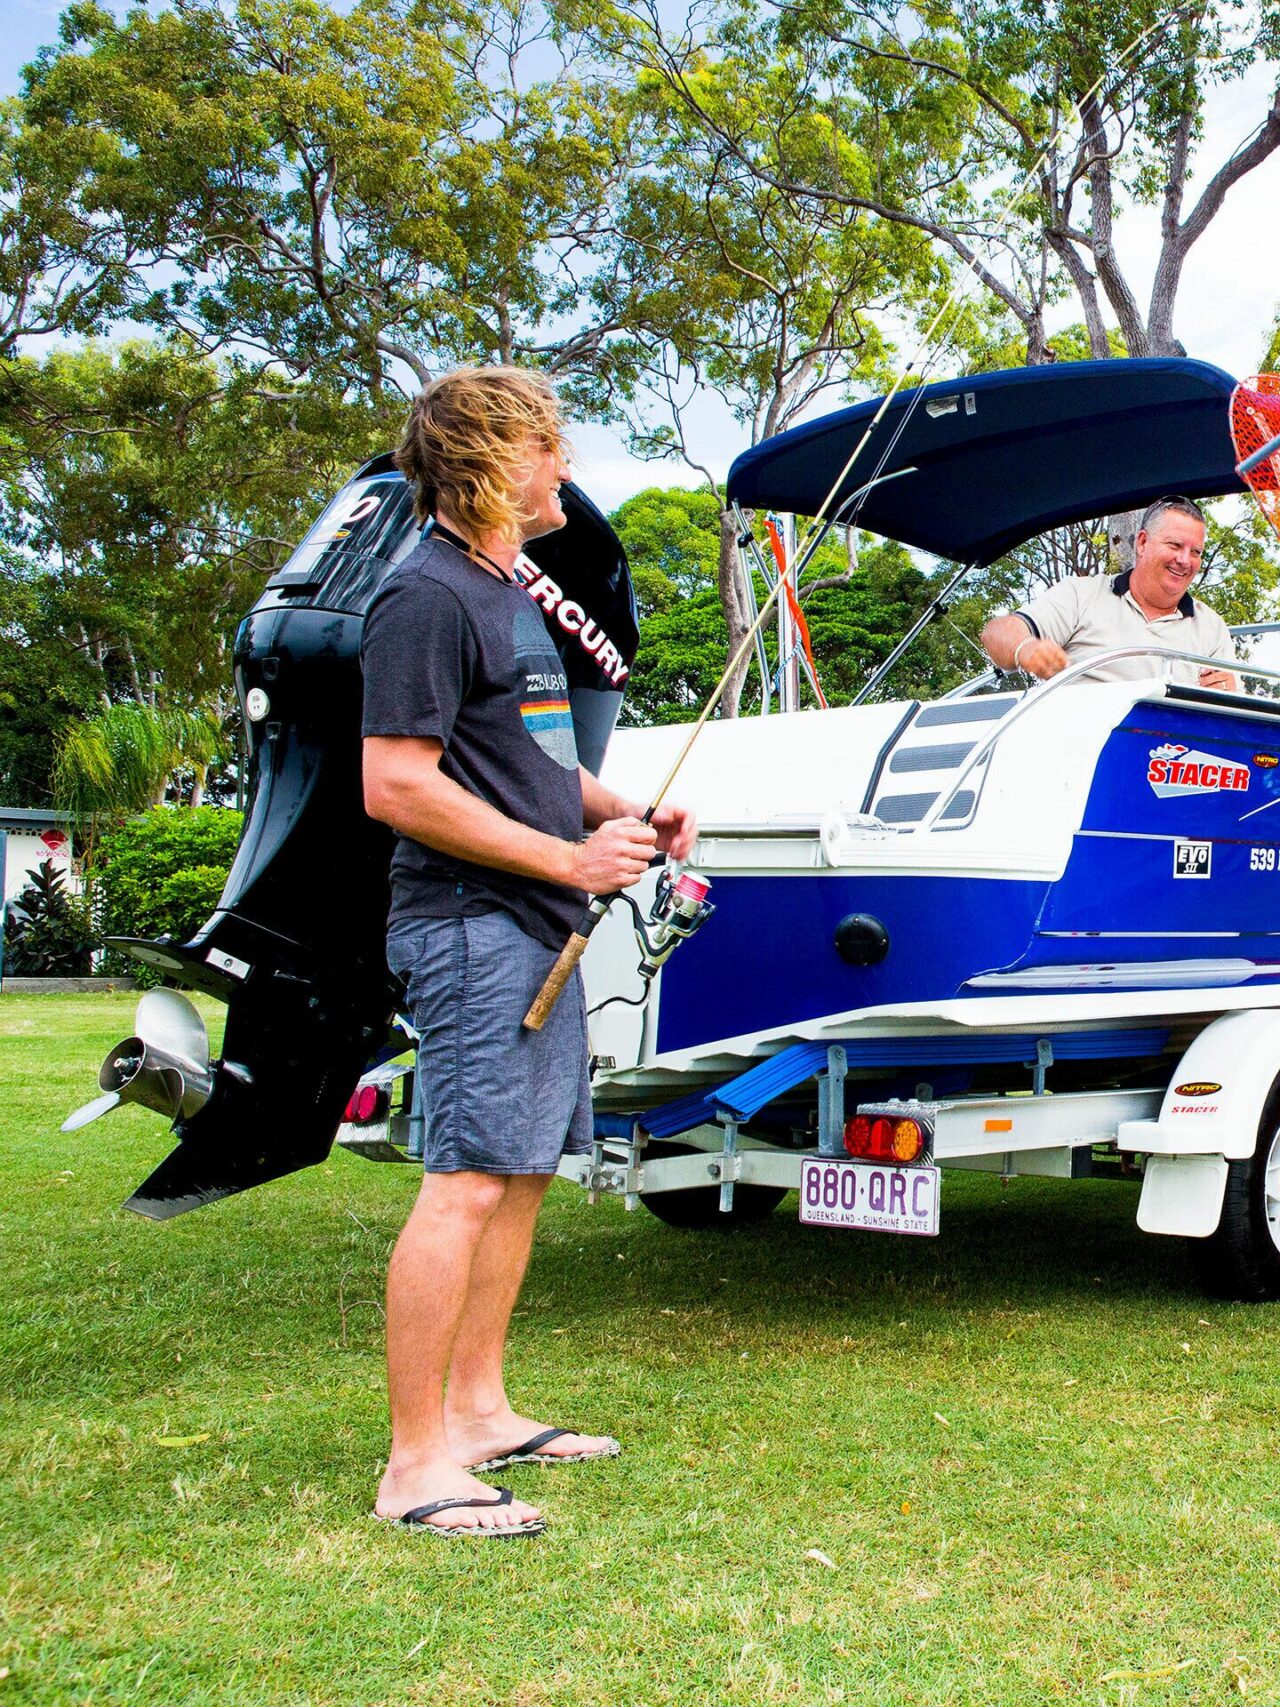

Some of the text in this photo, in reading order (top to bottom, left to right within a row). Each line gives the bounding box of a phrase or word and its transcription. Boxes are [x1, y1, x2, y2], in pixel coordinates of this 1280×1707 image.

[512, 551, 630, 688] ERCURY
[1256, 755, 1279, 764] NITRO
[1147, 758, 1251, 792] STACER
[1178, 846, 1209, 864] EVO
[1250, 847, 1275, 871] 539
[1182, 1084, 1221, 1092] NITRO
[1171, 1106, 1219, 1114] STACER
[807, 1210, 855, 1224] QUEENSLAND
[863, 1215, 900, 1229] SUNSHINE
[904, 1219, 929, 1231] STATE
